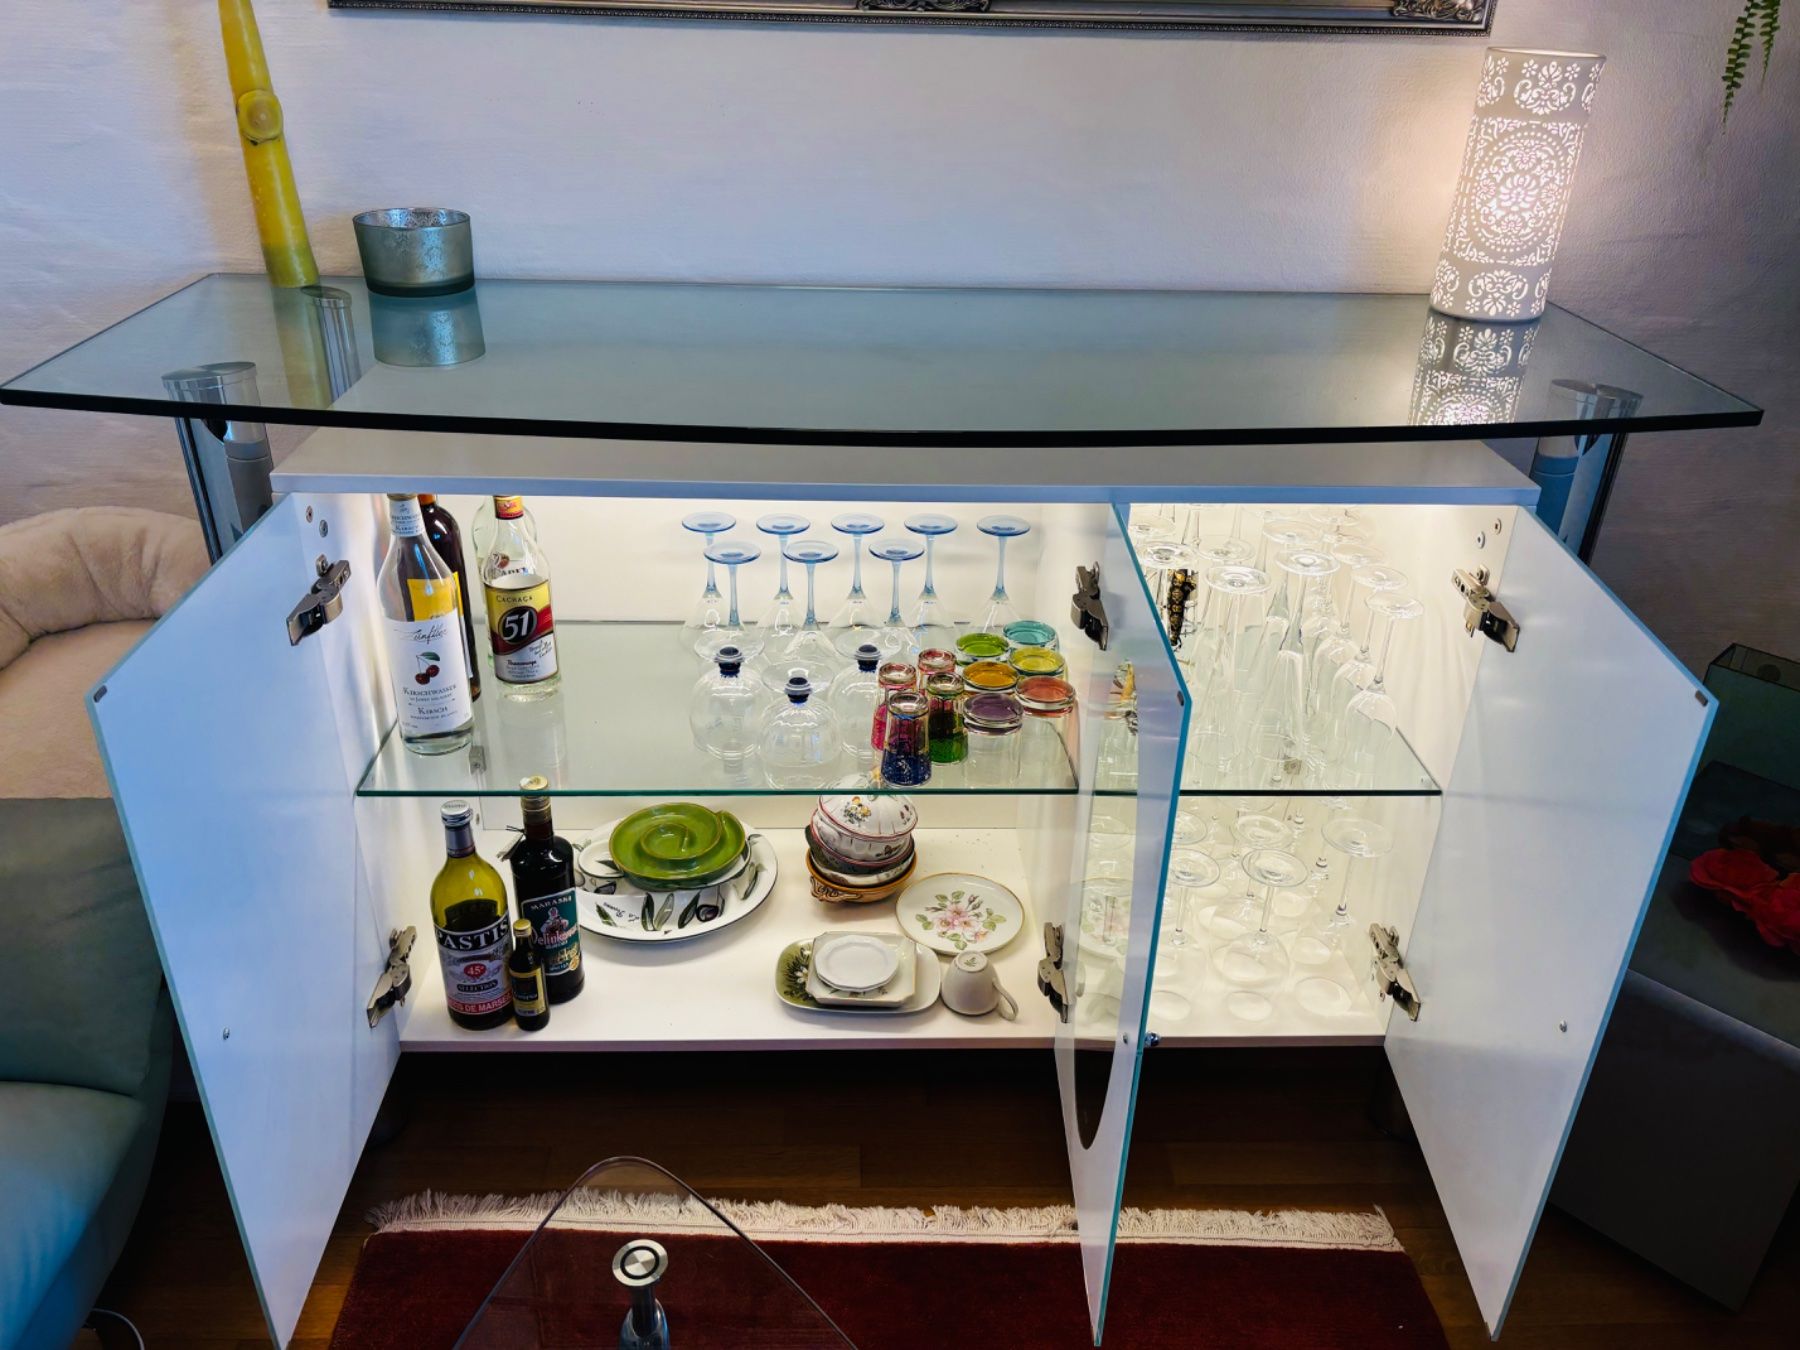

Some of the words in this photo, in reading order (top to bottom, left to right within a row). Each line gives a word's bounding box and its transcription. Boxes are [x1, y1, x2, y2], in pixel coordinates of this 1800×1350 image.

[503, 611, 530, 641] 51
[417, 706, 448, 715] KIRSCH
[465, 1003, 477, 1013] DE
